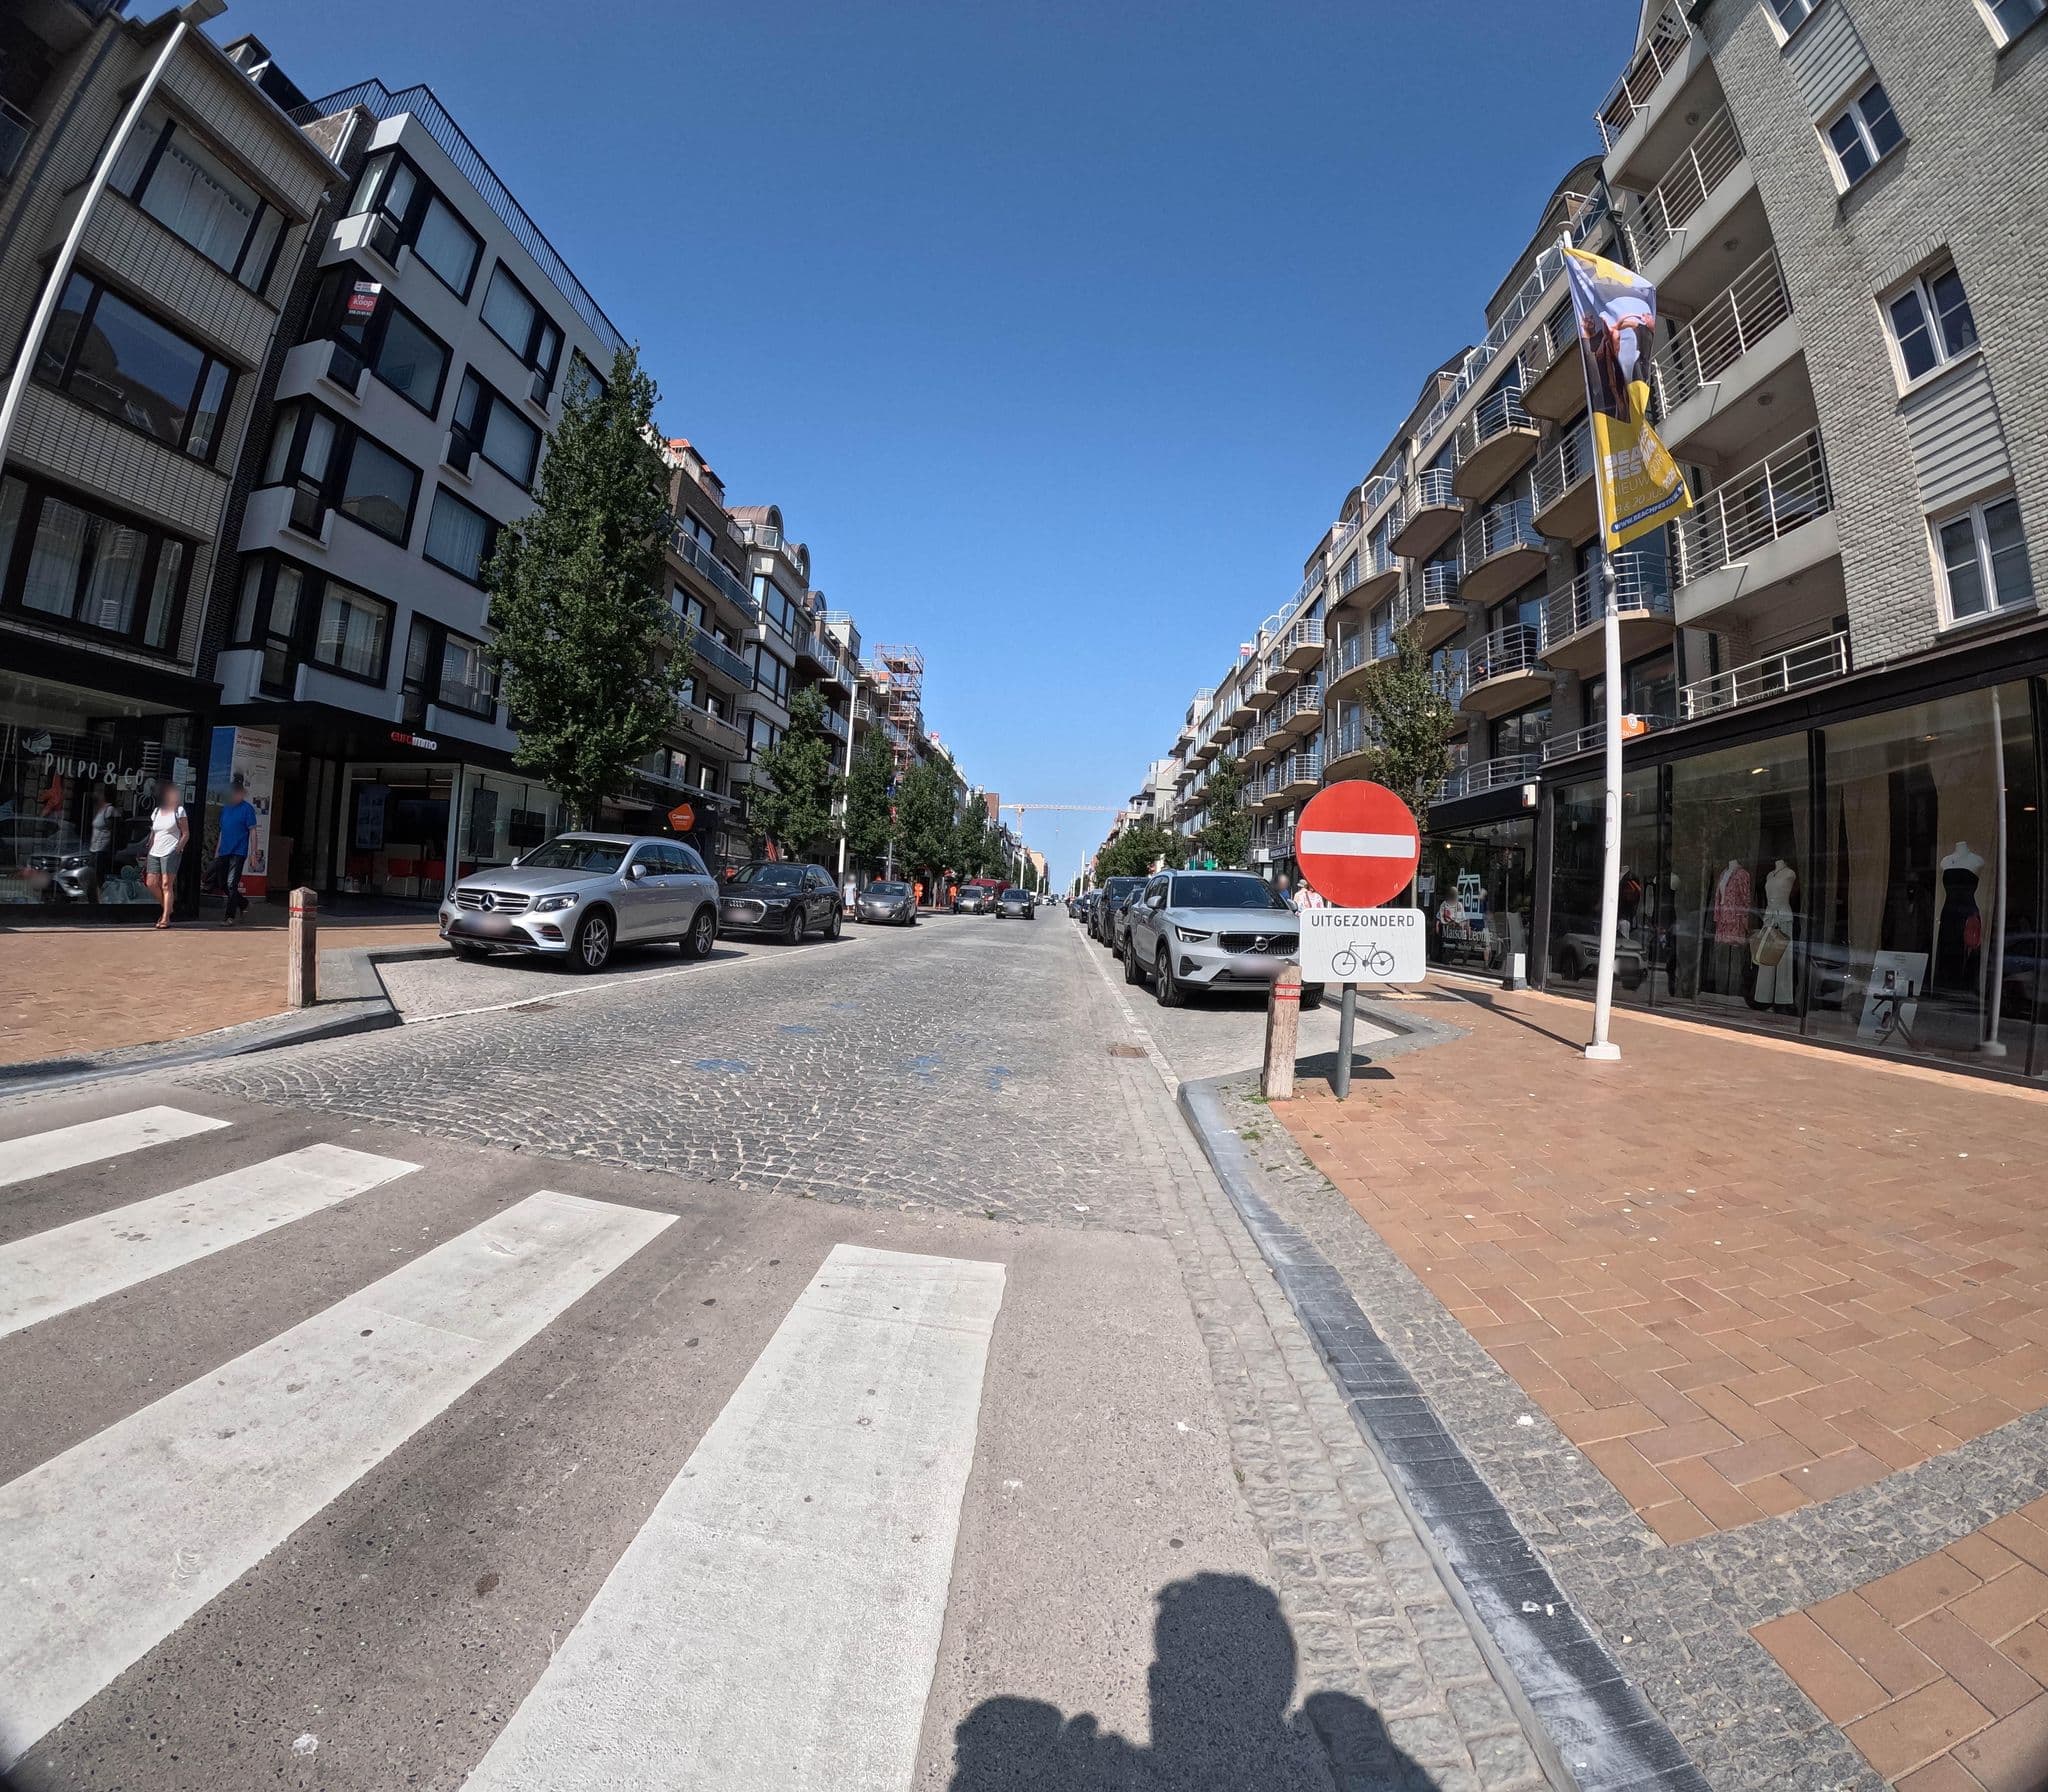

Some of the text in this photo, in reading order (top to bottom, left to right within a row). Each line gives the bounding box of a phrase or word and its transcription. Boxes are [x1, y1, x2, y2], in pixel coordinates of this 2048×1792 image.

[390, 731, 437, 750] euroimmo
[44, 753, 98, 779] PULPO
[104, 762, 117, 785] &
[1311, 914, 1415, 927] UITGEZONDERD
[1441, 924, 1467, 940] Maison
